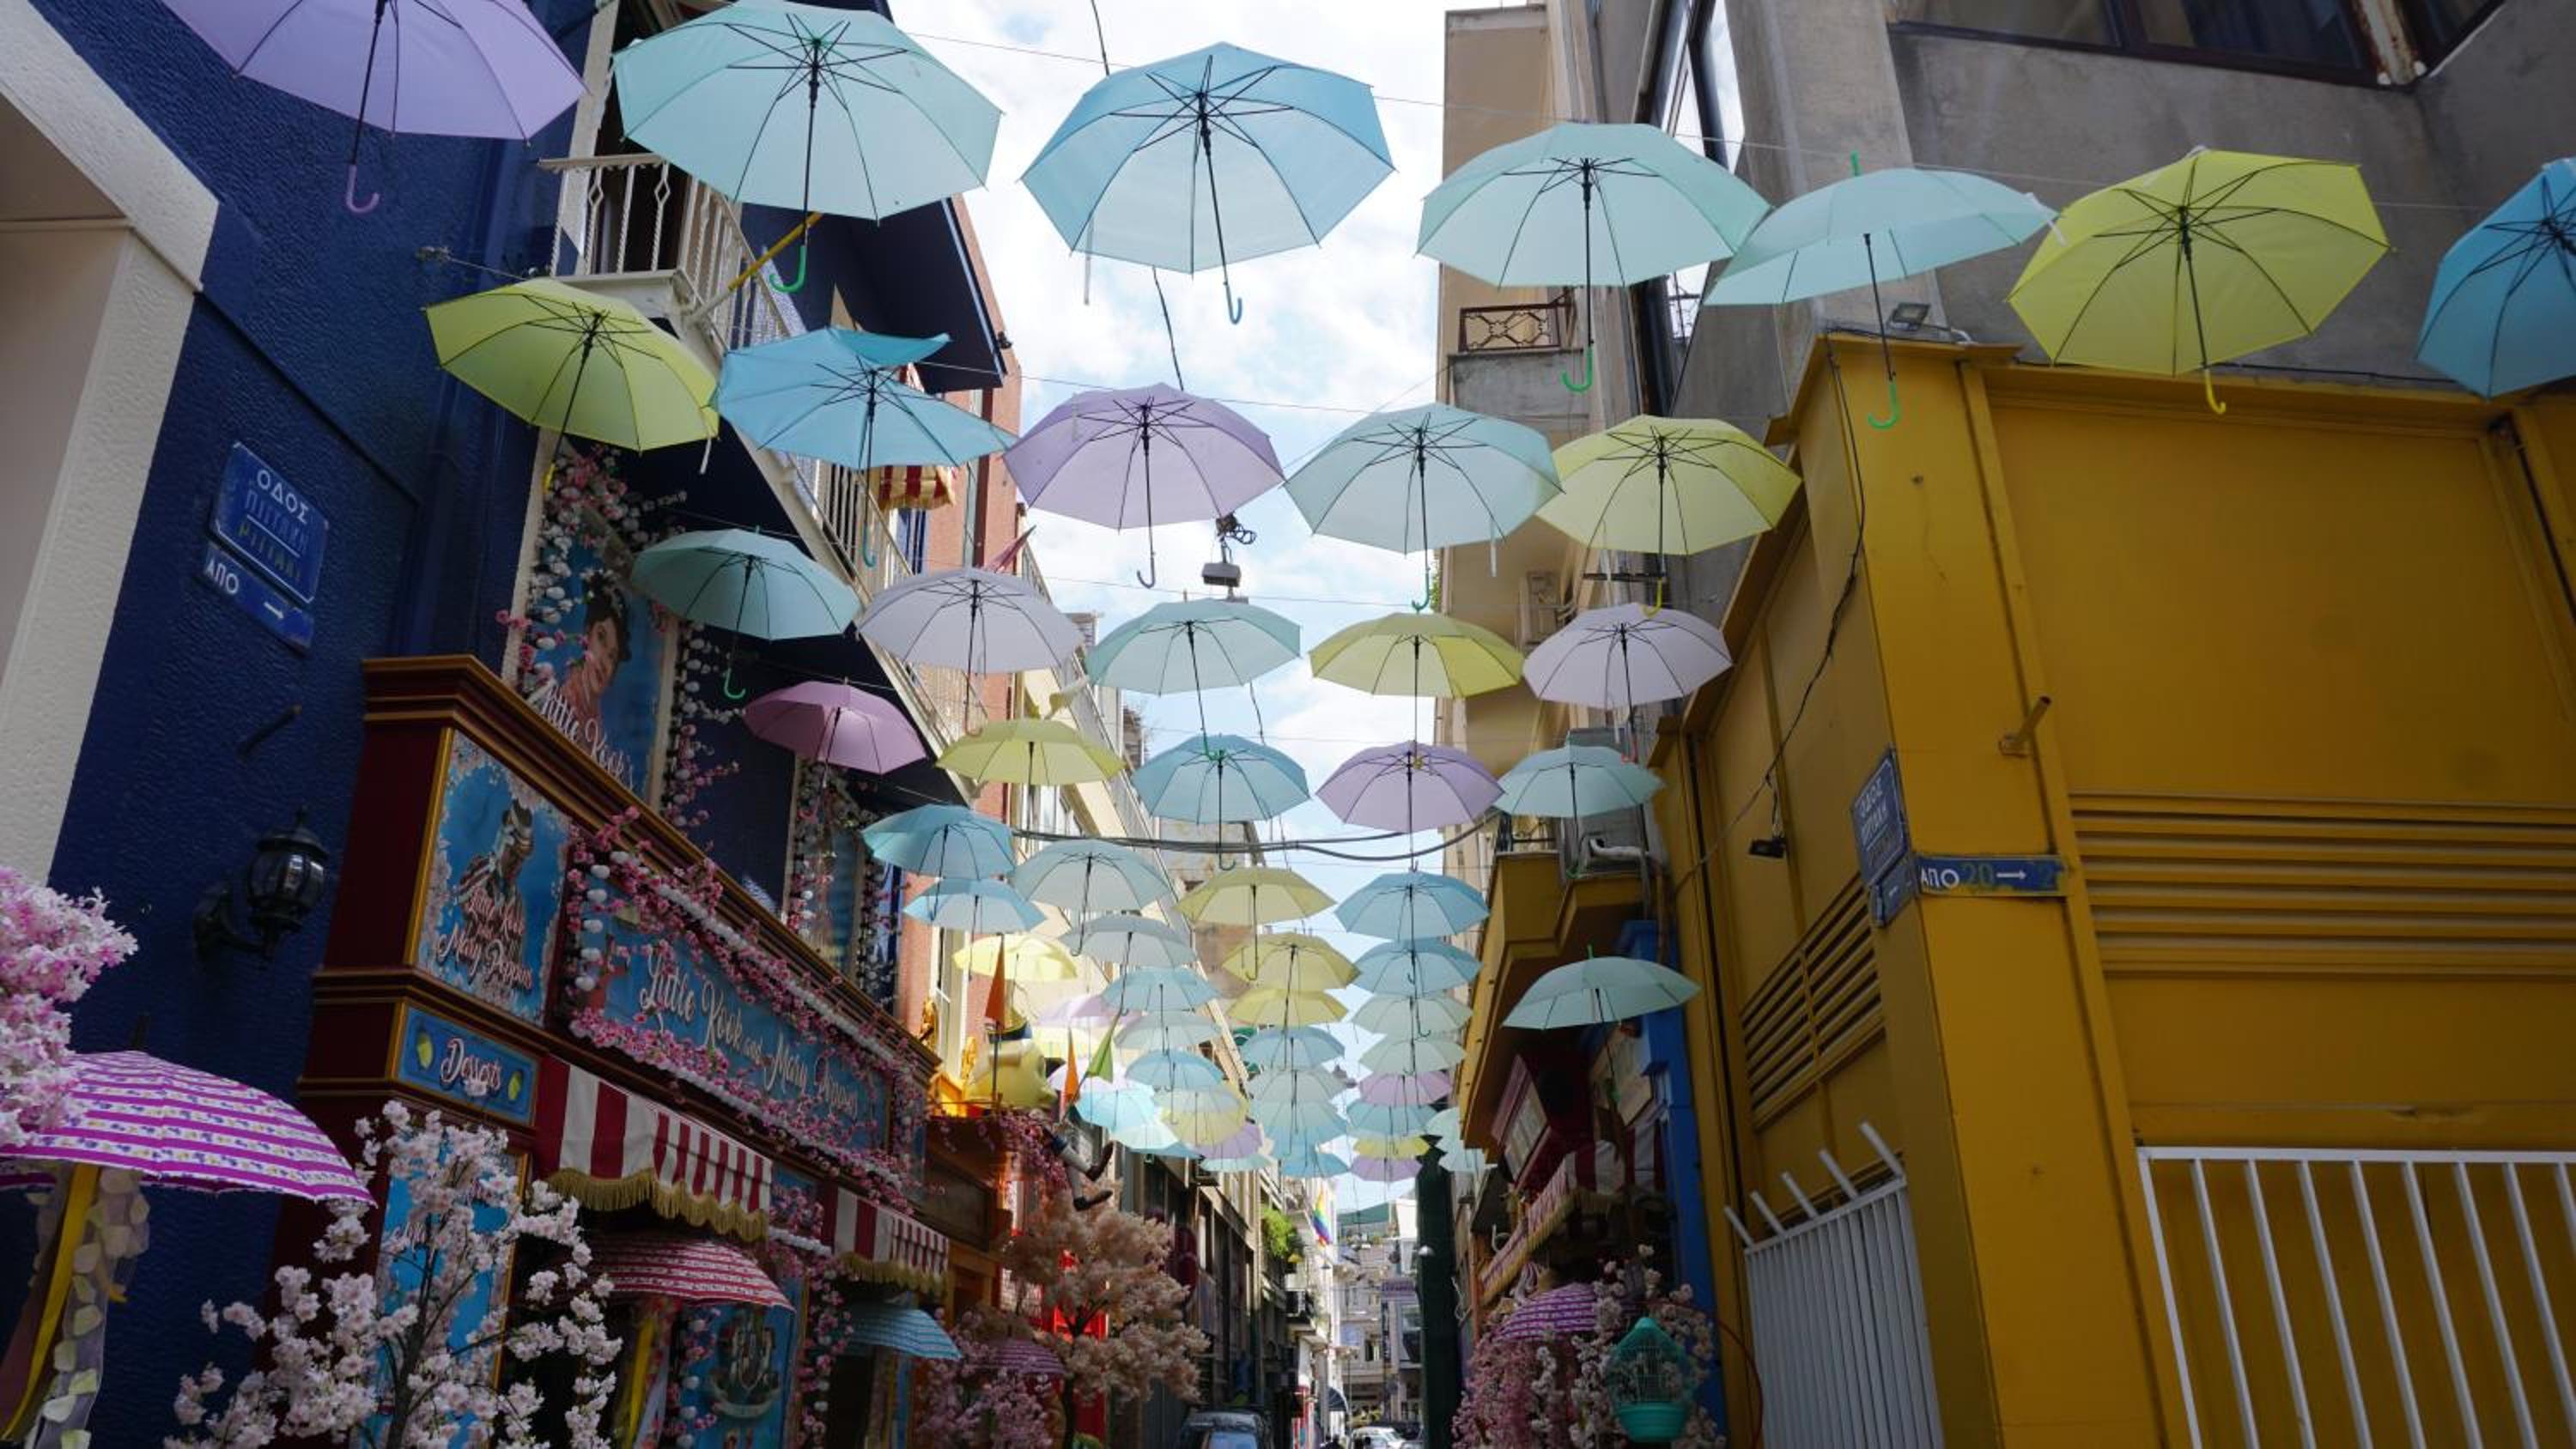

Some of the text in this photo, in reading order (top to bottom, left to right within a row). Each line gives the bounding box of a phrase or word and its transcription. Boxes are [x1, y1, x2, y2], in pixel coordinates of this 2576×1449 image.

[257, 470, 309, 525] ΟΔΟΣ
[206, 558, 240, 595] ΑΠΟ
[1919, 867, 1960, 889] ΑΠΟ
[436, 922, 483, 977] Mary
[639, 943, 695, 1032] Little
[701, 979, 743, 1049] Kook
[762, 1033, 808, 1099] Mary
